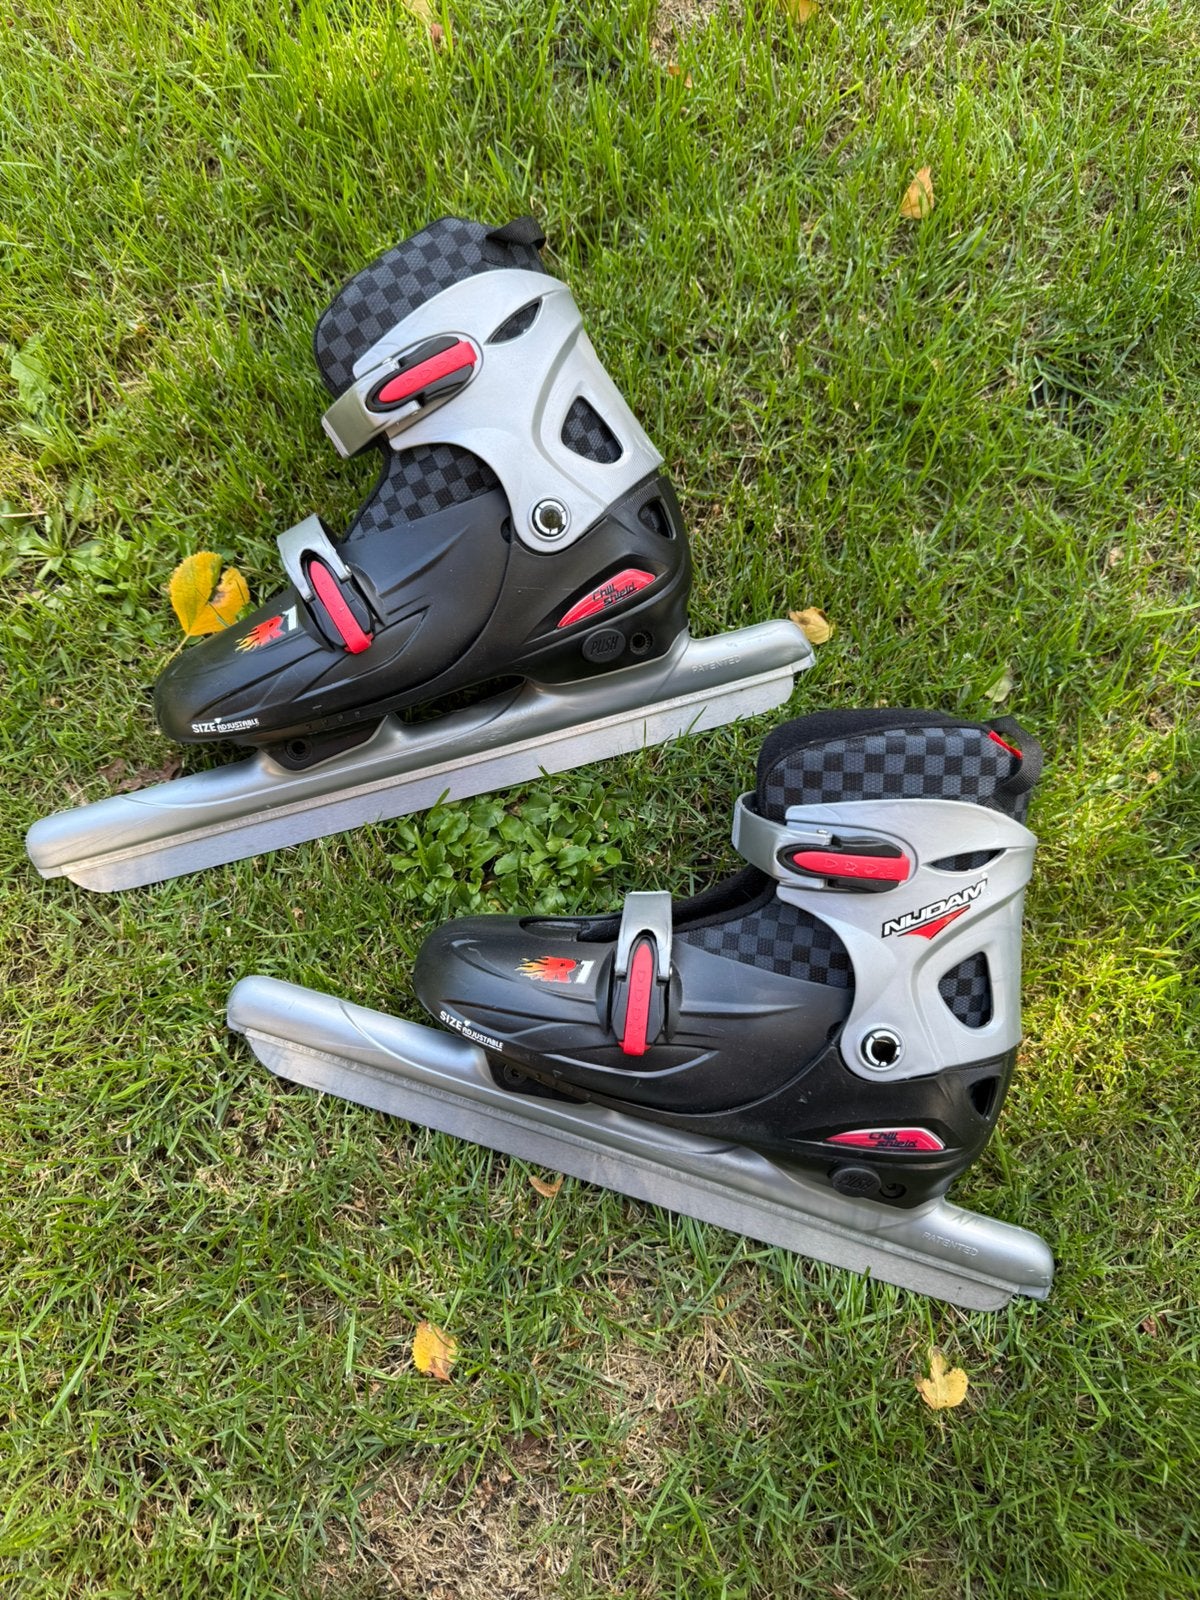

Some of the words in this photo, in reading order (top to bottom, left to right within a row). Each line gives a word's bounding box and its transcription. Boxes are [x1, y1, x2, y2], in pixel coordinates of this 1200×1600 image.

[591, 635, 619, 656] PUSH
[692, 655, 741, 673] PATENTED
[191, 722, 217, 733] SIZE
[216, 718, 260, 733] ADJUSTABLE
[881, 878, 988, 938] NIJDAM
[439, 1010, 463, 1031] SIZE
[462, 1026, 504, 1051] ADJUSTABLE
[921, 1231, 979, 1257] PATENTED
